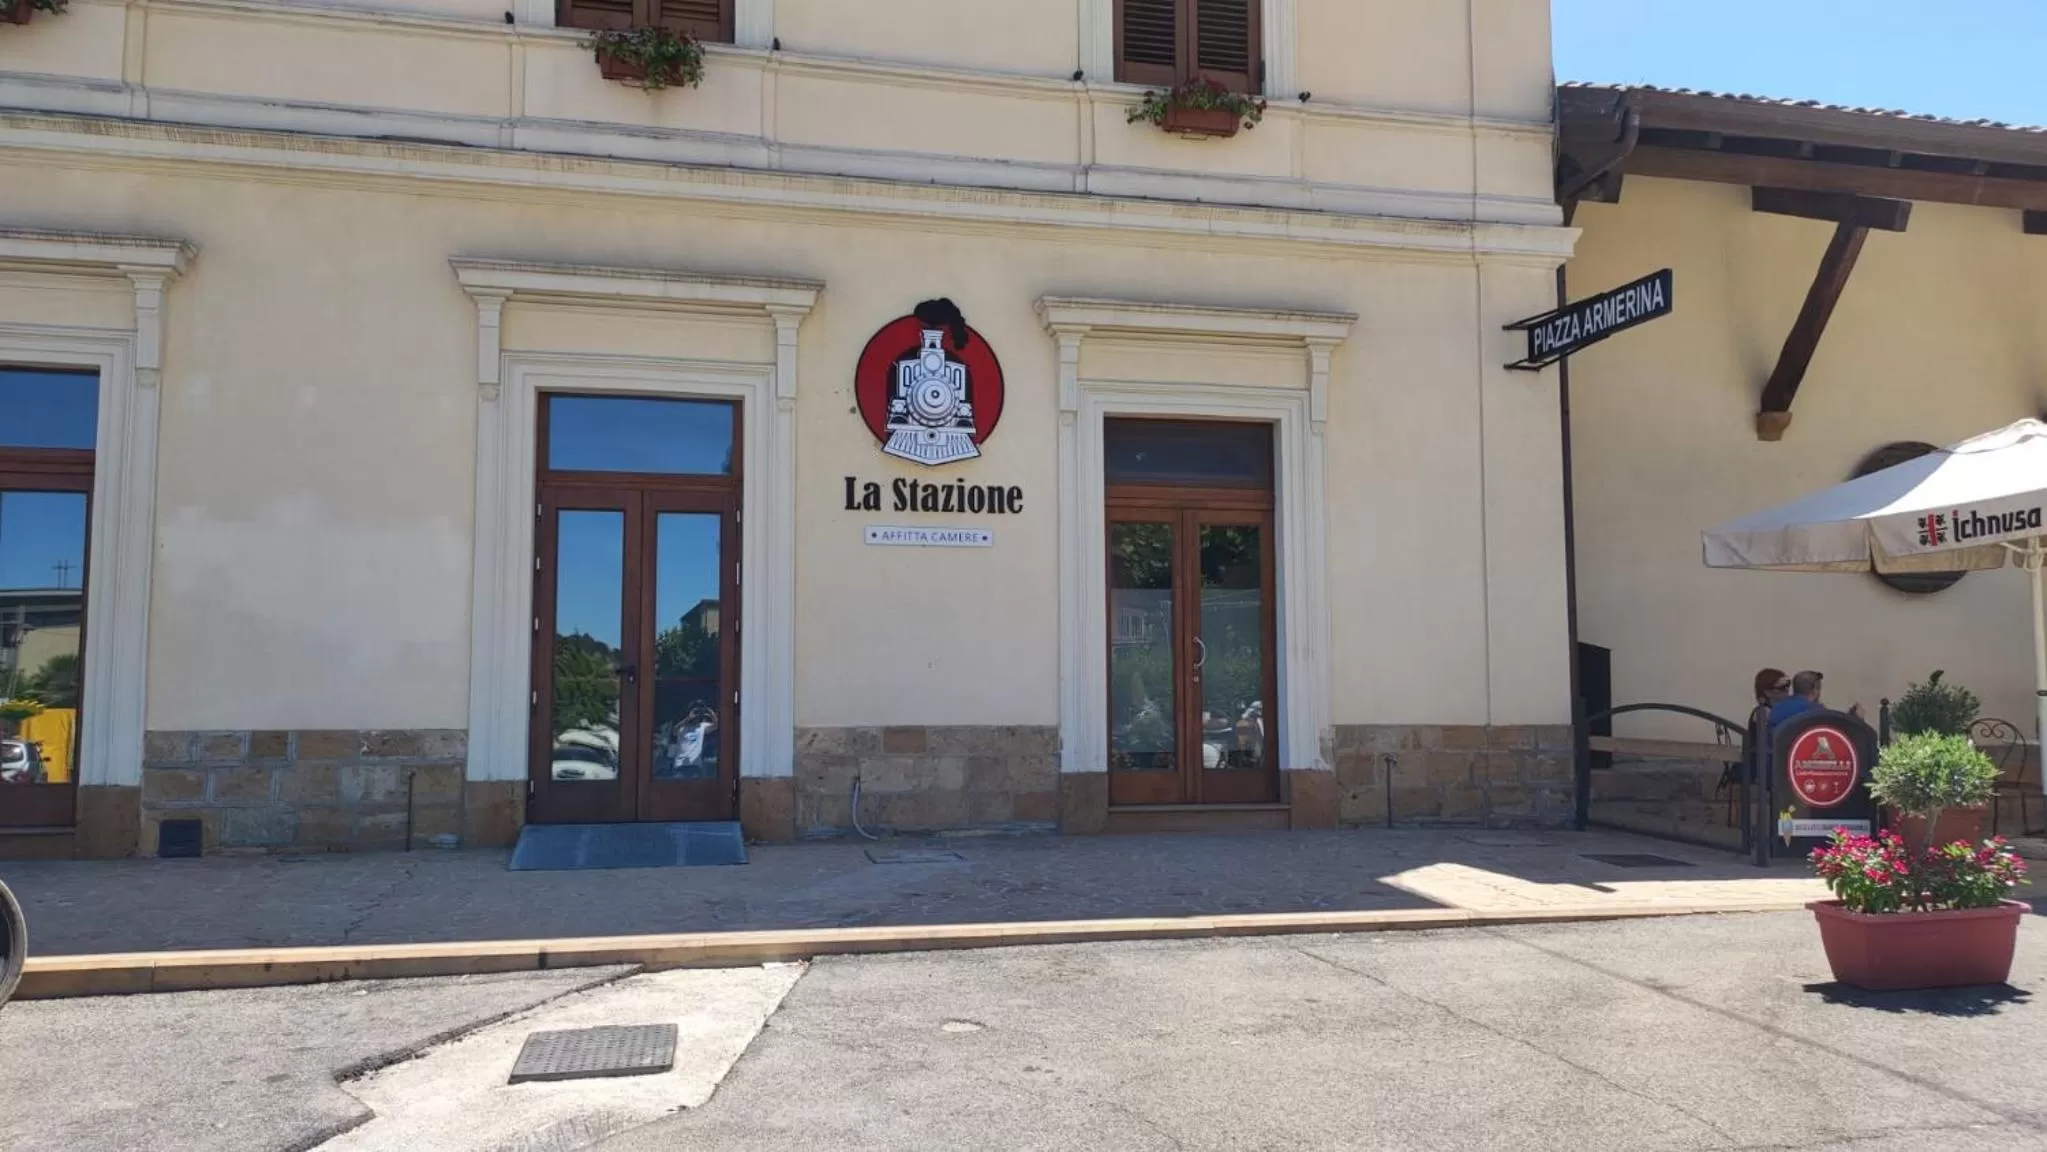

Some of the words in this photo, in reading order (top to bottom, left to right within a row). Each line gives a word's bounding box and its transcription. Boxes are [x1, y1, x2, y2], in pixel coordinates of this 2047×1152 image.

[1534, 314, 1580, 354] PIAZZA
[1583, 279, 1664, 336] ARMERINA
[844, 476, 881, 512] La
[893, 477, 1023, 513] Stazione
[882, 531, 928, 543] AFFITTA
[931, 532, 978, 544] CAMERE
[1952, 507, 2041, 542] ichnusa
